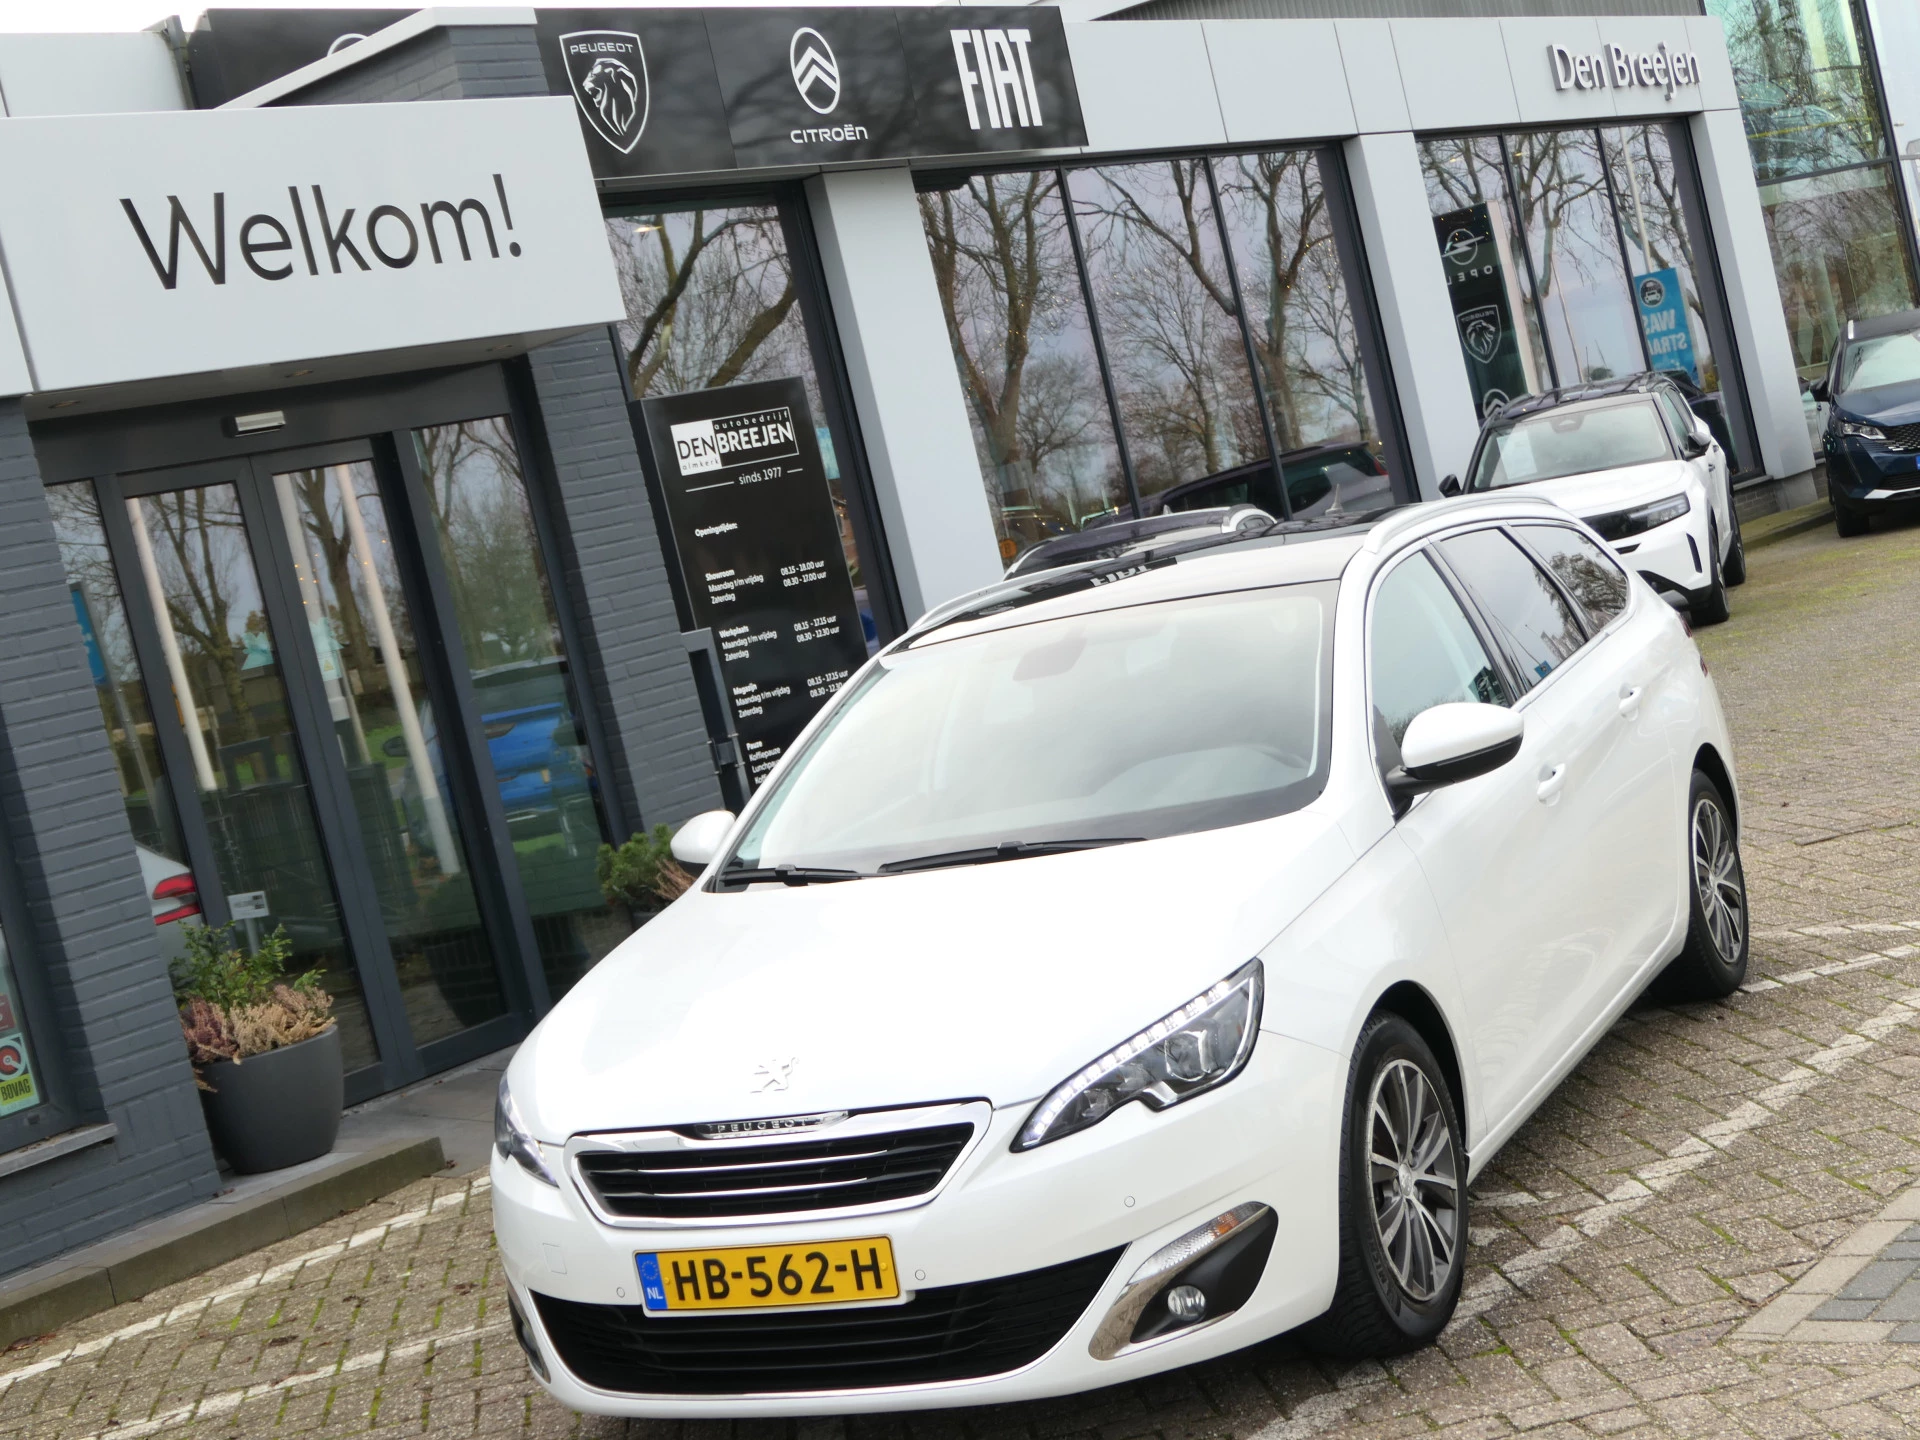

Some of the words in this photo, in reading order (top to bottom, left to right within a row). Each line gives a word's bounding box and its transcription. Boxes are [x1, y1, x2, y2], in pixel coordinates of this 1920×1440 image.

[569, 42, 634, 56] PEUGEOT
[949, 28, 1044, 131] FIAT
[1546, 43, 1606, 92] Den
[1604, 41, 1702, 101] Breejen
[789, 125, 869, 145] CITROËN
[119, 173, 522, 290] Welkom!
[713, 410, 789, 430] autobedrijf
[677, 435, 718, 460] DEN
[716, 421, 794, 454] BREEJEN
[682, 458, 719, 471] almkerk
[738, 471, 762, 485] sinds
[762, 467, 782, 481] 1977
[705, 569, 735, 581] Showroom
[746, 740, 763, 751] Pauze
[0, 1077, 31, 1101] BOVAG
[716, 1118, 807, 1134] PEUGEOT
[671, 1247, 883, 1301] HB-562-H
[647, 1286, 664, 1301] NL
